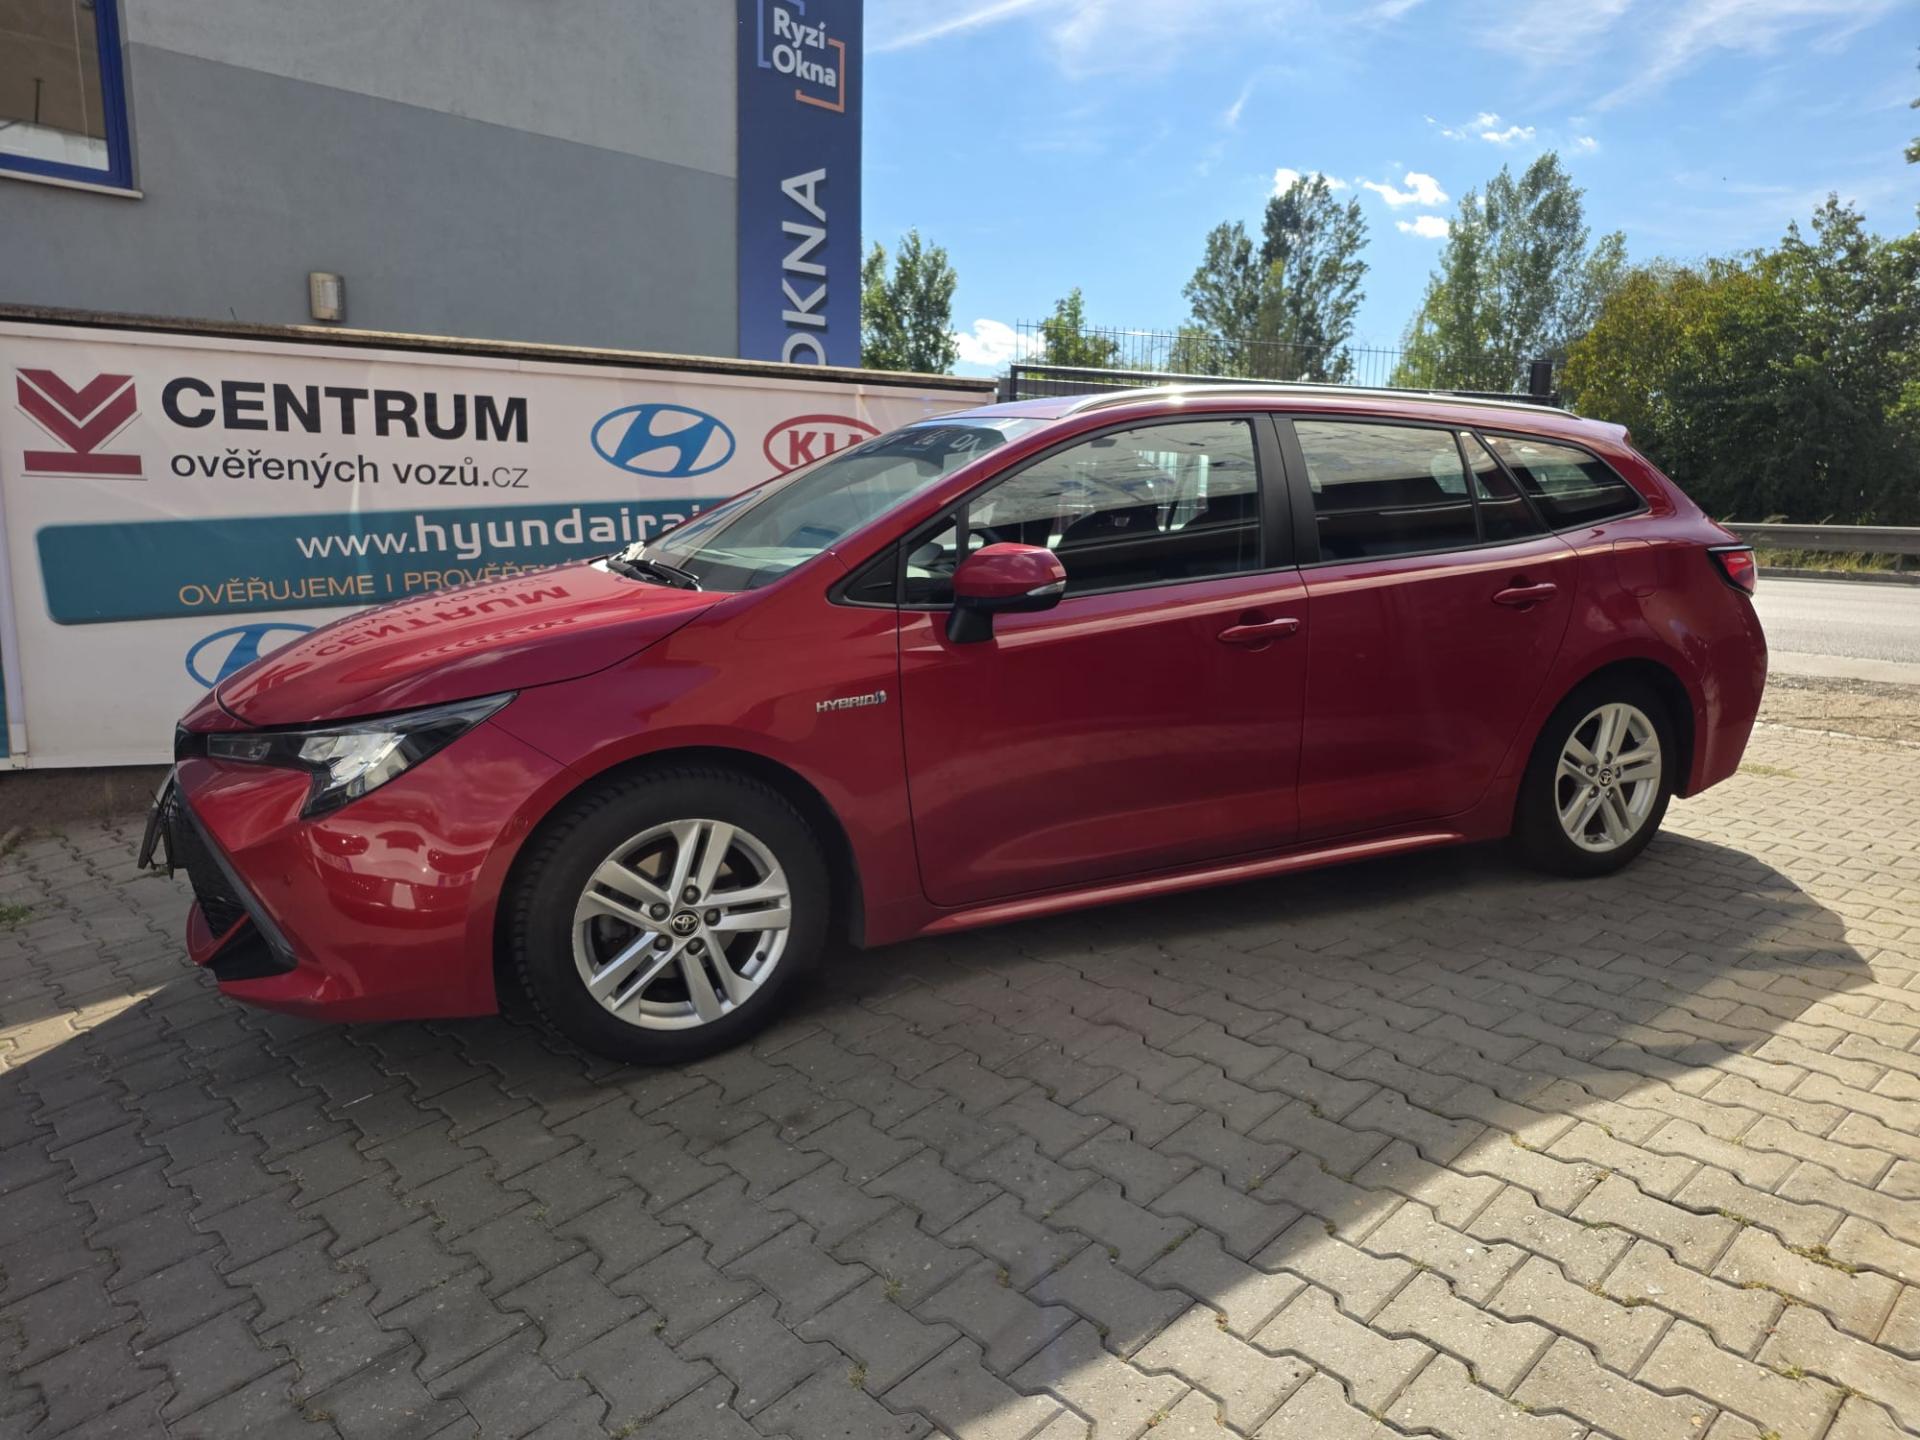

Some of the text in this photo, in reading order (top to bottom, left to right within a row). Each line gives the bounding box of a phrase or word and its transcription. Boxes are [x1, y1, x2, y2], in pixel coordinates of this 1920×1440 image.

[773, 7, 826, 50] Ryzí
[772, 44, 837, 88] Okna
[781, 167, 827, 366] OKNA
[161, 376, 529, 443] CENTRUM
[170, 447, 379, 489] ověřených
[296, 504, 700, 560] www.hyundaira
[178, 574, 376, 606] OVĚŘUJEME
[386, 573, 393, 593] I
[816, 694, 877, 713] HYBRID
